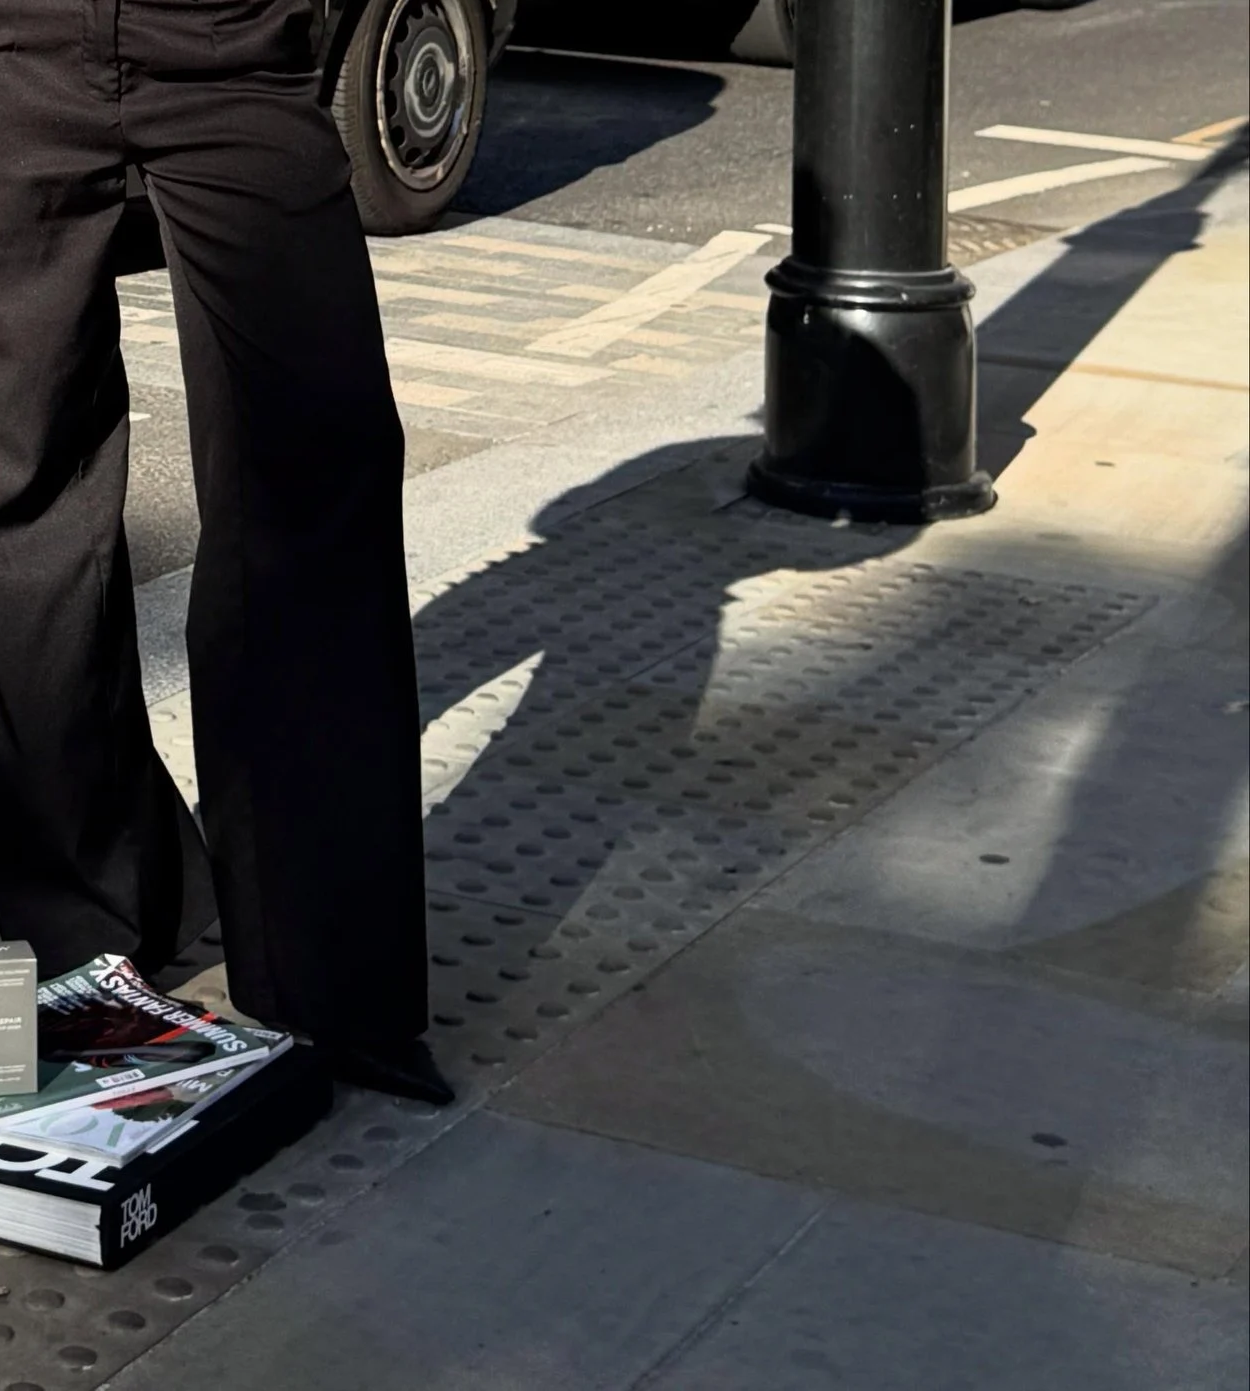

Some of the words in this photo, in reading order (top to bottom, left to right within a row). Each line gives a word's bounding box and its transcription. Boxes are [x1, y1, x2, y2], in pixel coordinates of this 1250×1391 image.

[89, 960, 174, 1016] FANTASY
[163, 1010, 248, 1052] SUMMER
[120, 1183, 152, 1225] TOM
[120, 1202, 158, 1248] FORD
